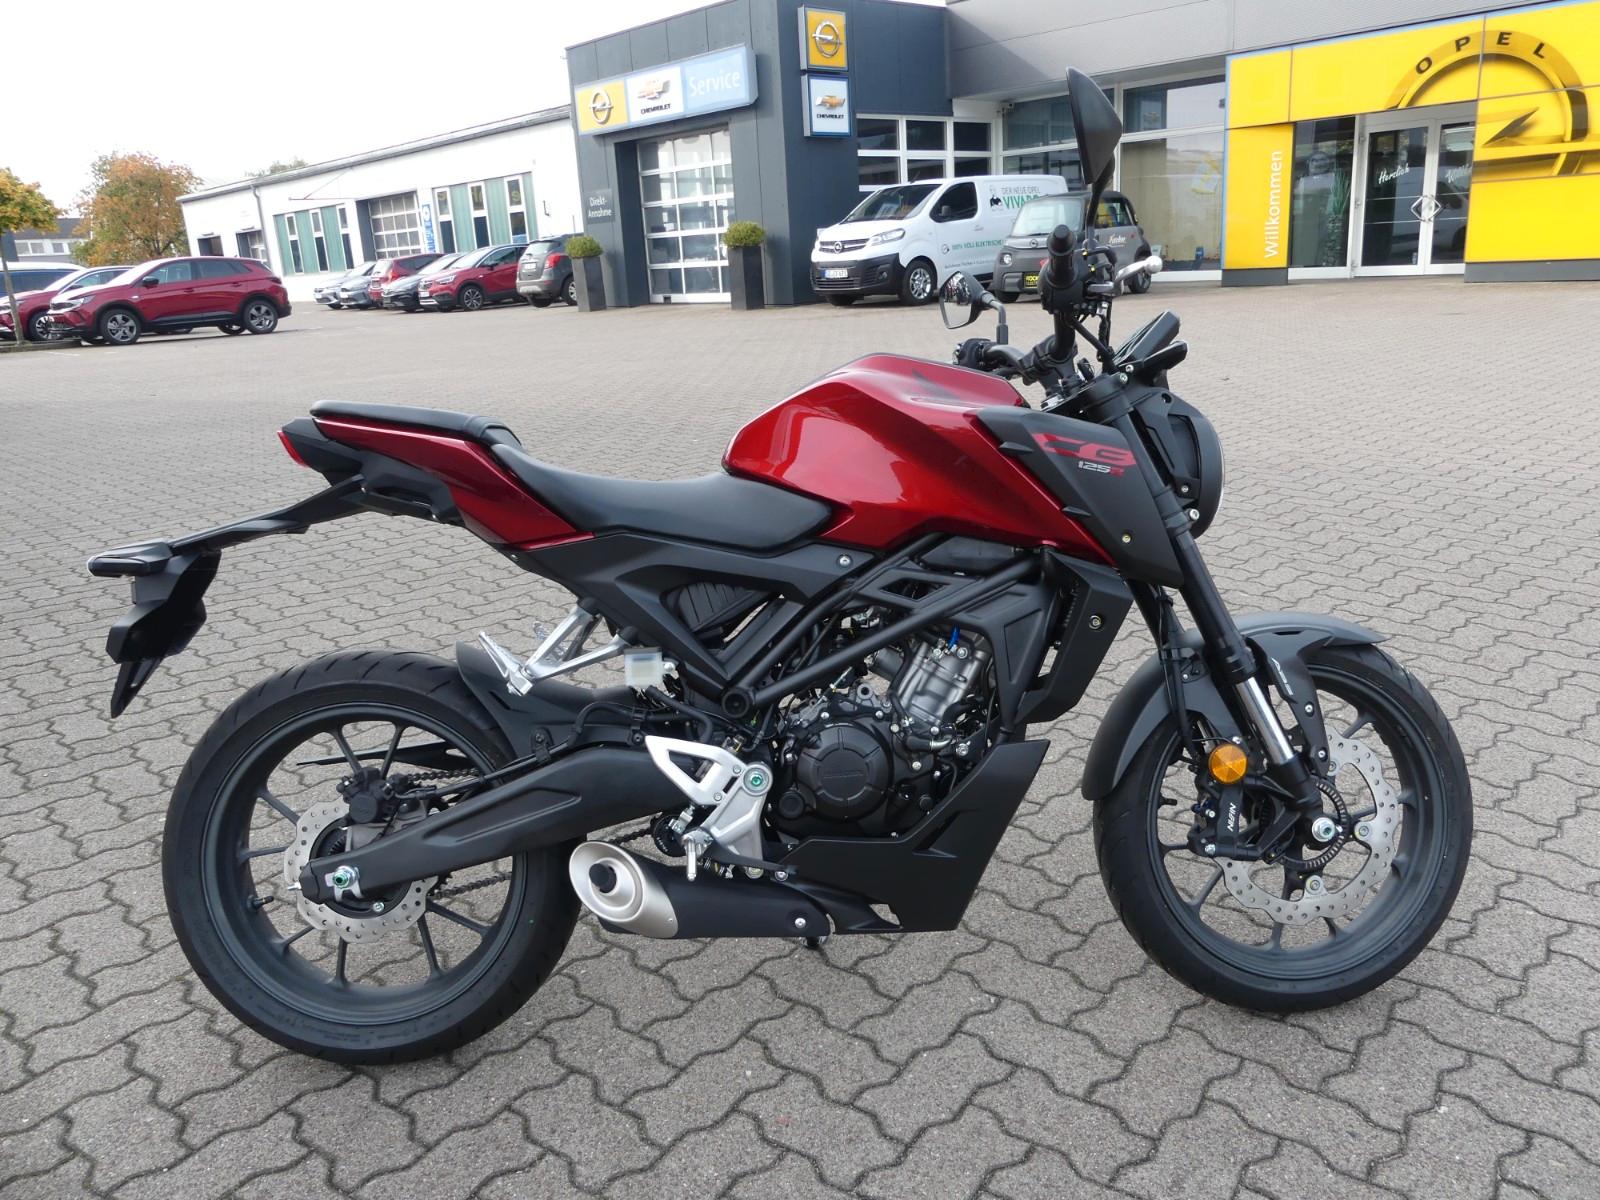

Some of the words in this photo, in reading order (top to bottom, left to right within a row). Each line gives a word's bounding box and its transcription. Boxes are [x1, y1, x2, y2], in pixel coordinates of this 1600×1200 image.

[1415, 30, 1547, 75] OPEL
[689, 69, 741, 97] Service
[640, 103, 671, 115] CHEVROLET
[1378, 163, 1410, 184] Herzlich
[1264, 151, 1283, 259] Willkommen
